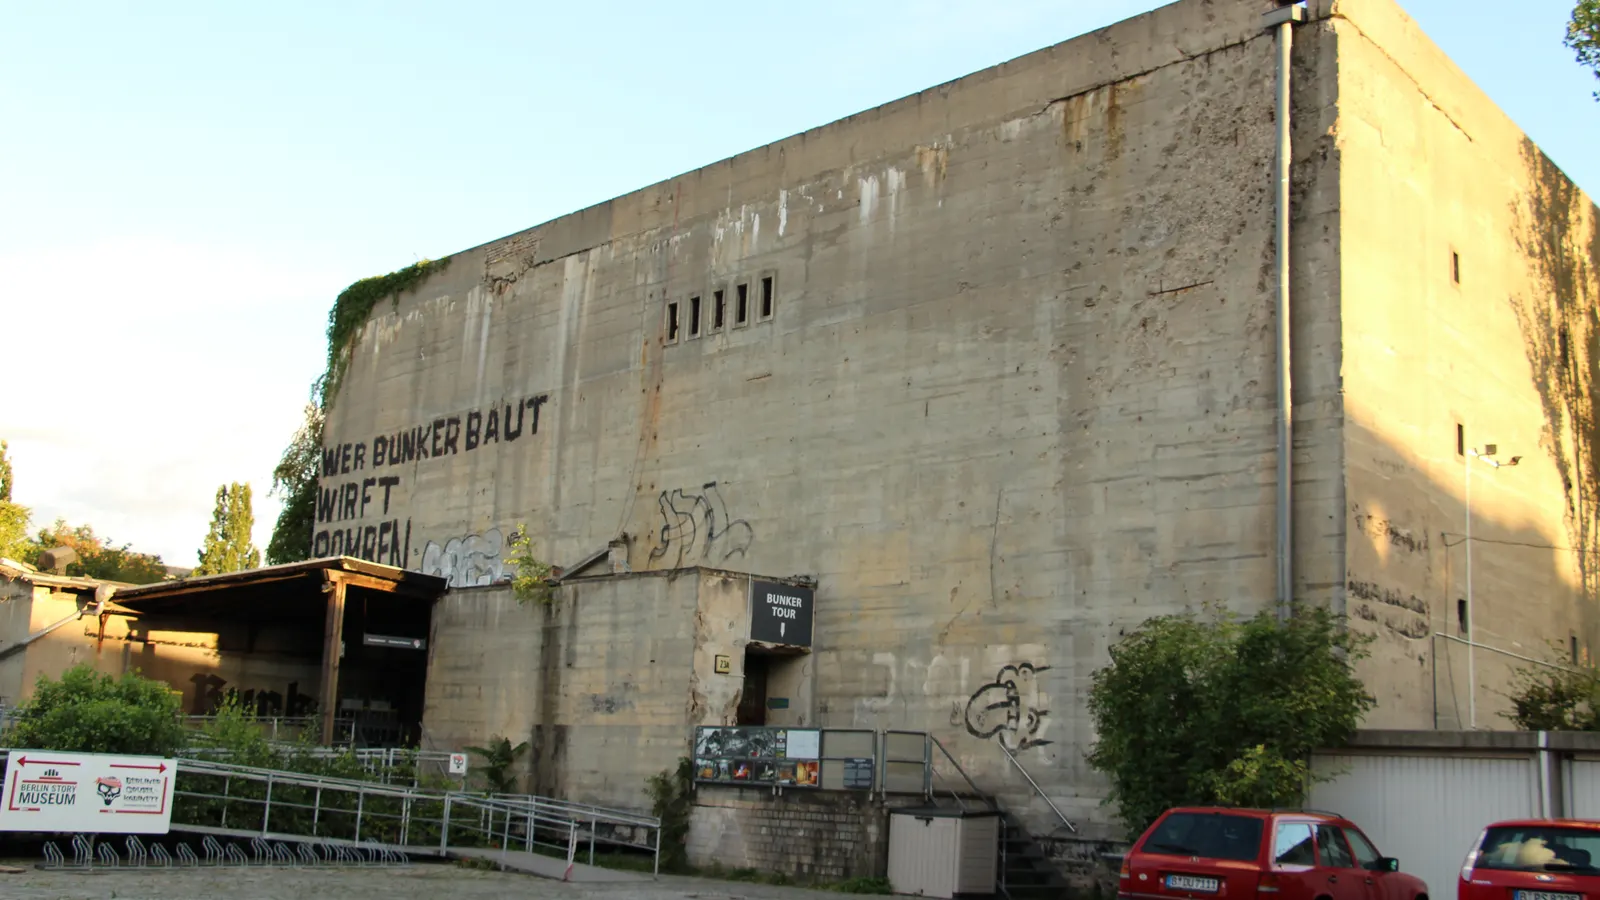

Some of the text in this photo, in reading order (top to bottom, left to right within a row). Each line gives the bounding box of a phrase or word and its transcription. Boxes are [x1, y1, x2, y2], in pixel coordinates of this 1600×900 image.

[321, 395, 548, 478] WER BUNKER BAUT
[317, 476, 400, 522] WIRFT
[766, 593, 802, 608] BUNKER
[771, 606, 796, 619] TOUR
[20, 784, 77, 793] BERLIN STORY
[18, 792, 76, 805] MUSEUM
